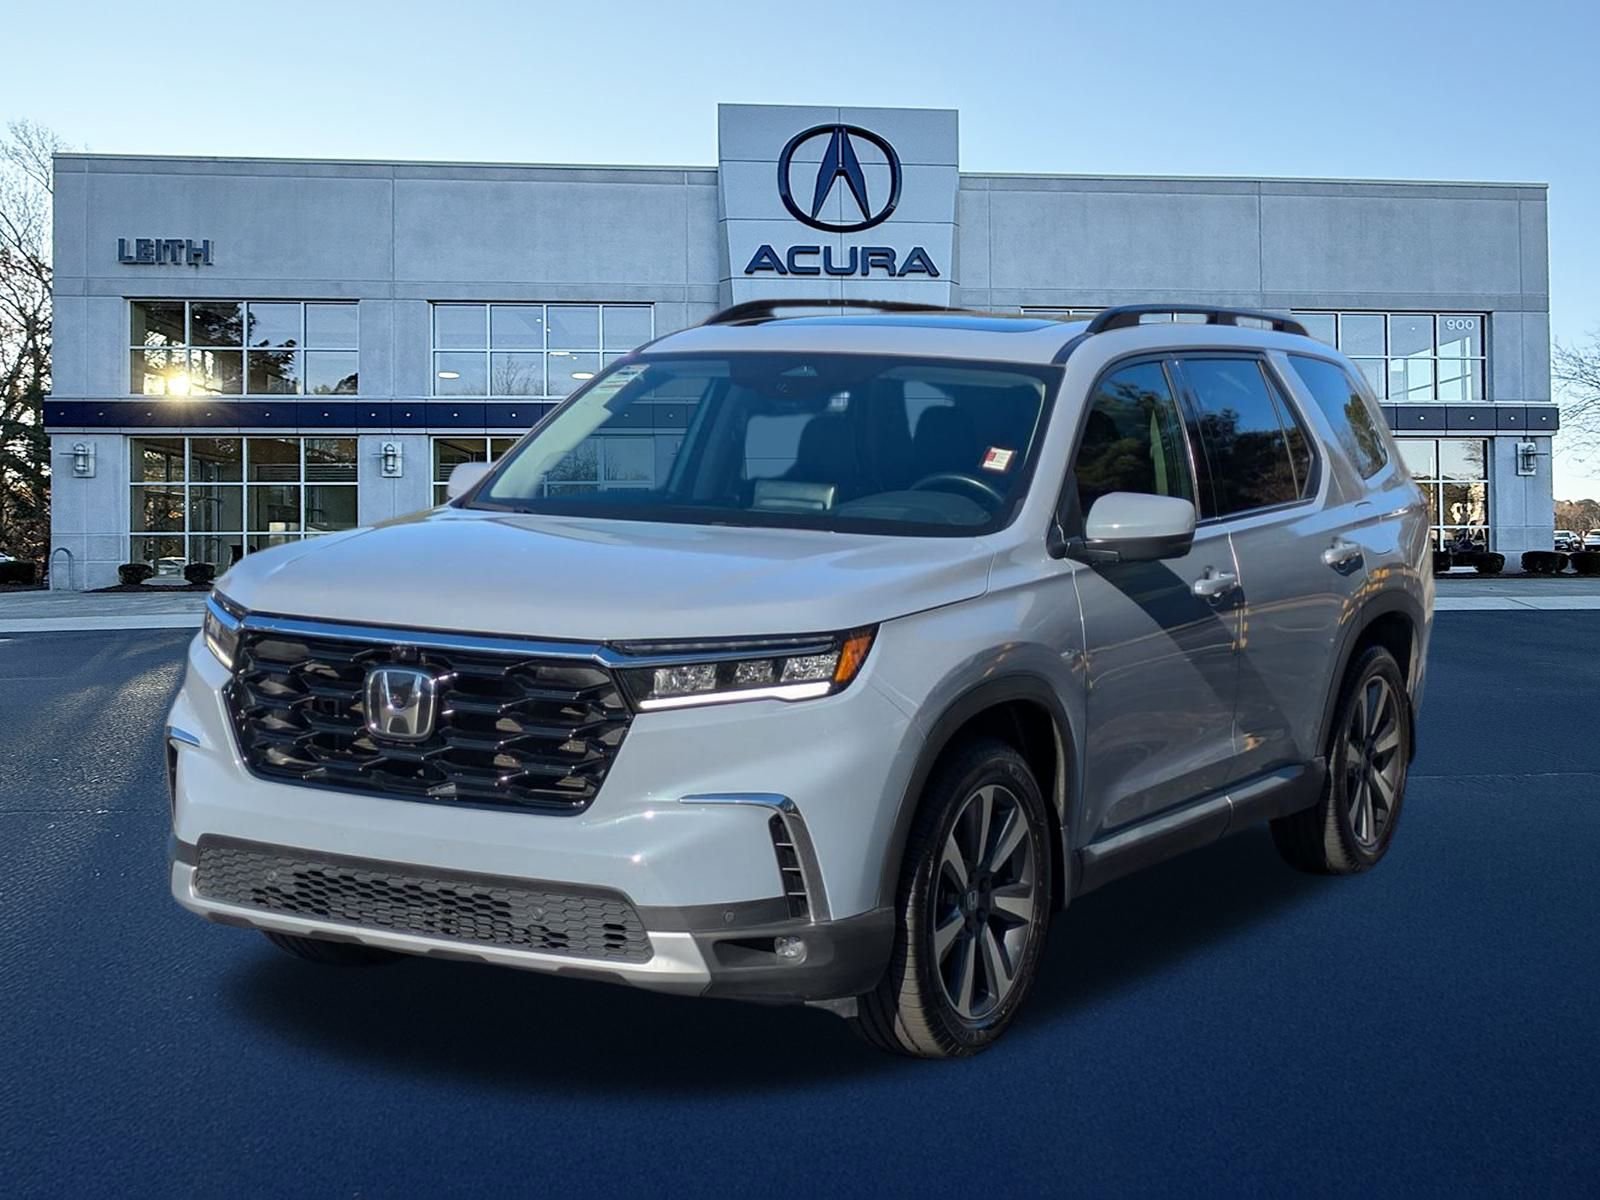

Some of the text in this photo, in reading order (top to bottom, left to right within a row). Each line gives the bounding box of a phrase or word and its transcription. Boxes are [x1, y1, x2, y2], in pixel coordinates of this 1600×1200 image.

[118, 238, 213, 265] LEITH
[744, 245, 940, 277] ACURA
[1446, 319, 1474, 330] 900
